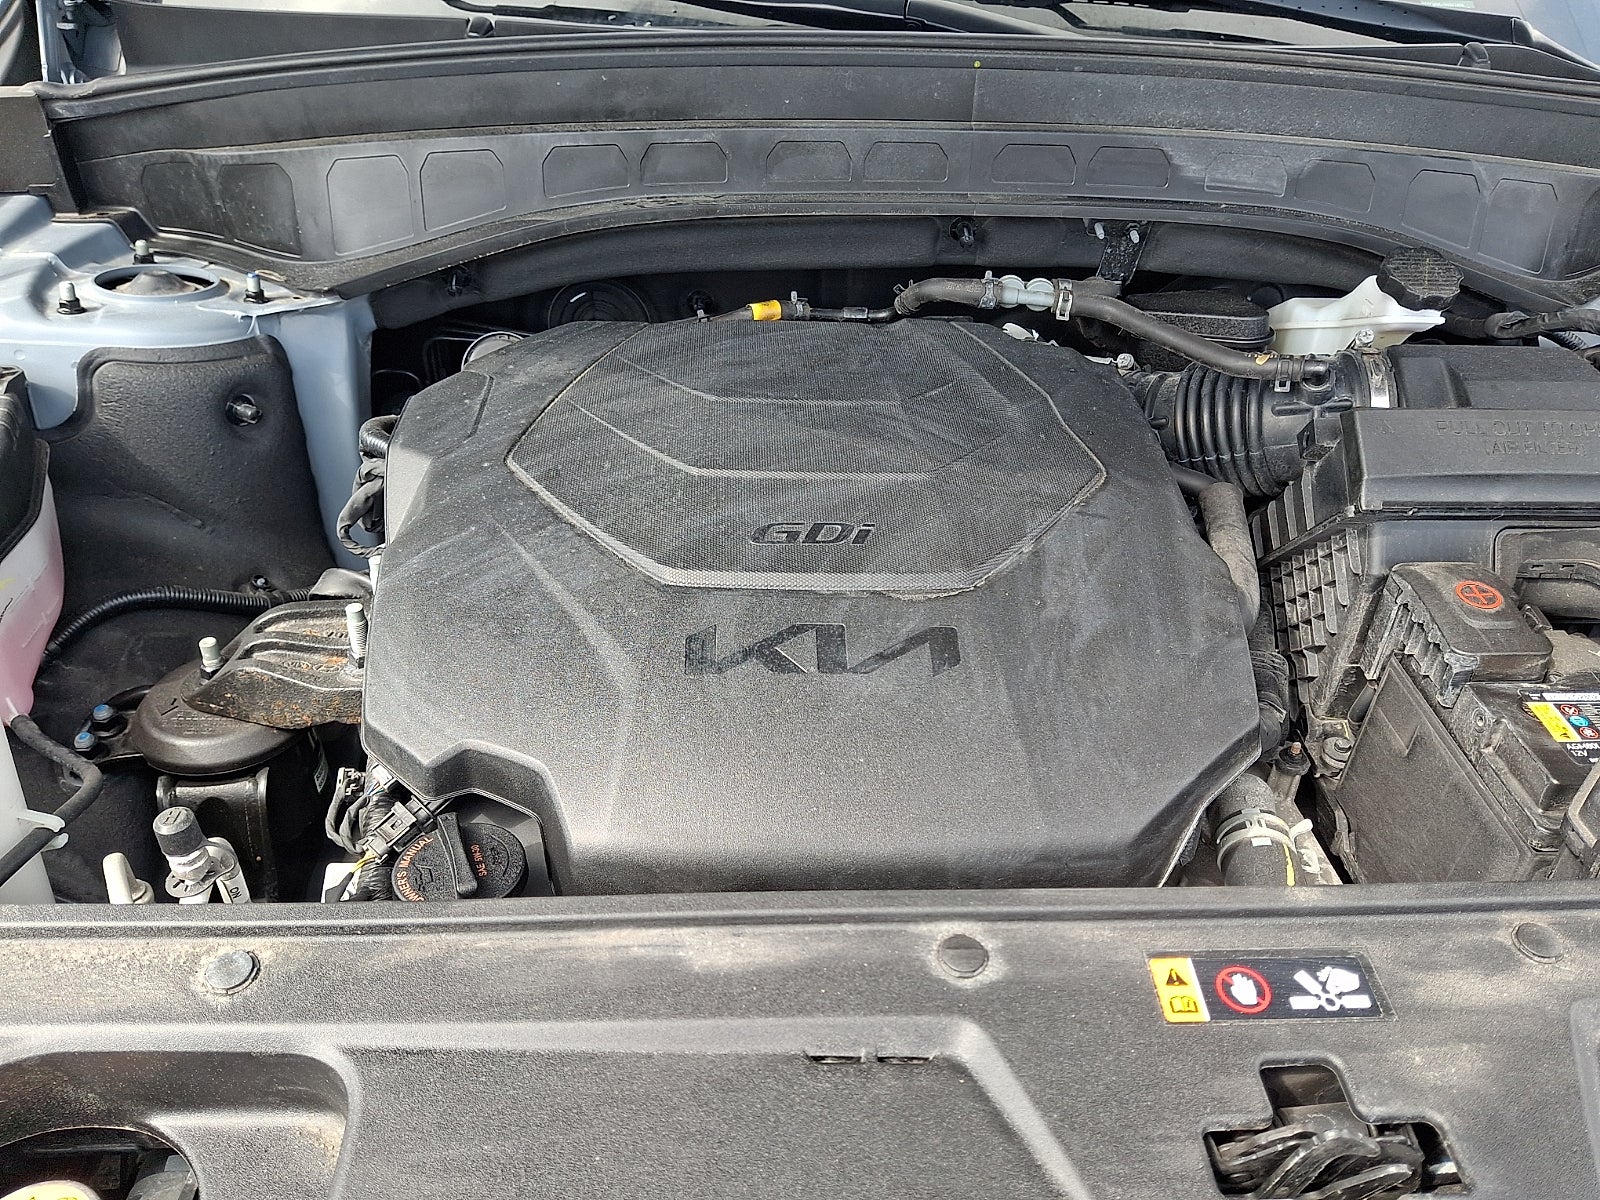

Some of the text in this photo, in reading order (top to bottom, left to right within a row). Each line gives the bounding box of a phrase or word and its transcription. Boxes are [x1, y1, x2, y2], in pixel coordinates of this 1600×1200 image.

[1493, 420, 1534, 436] OUT
[1542, 420, 1564, 436] TO
[750, 521, 875, 545] GDi
[685, 623, 961, 677] KIA
[399, 837, 434, 868] MANUAL
[478, 862, 488, 877] SAE
